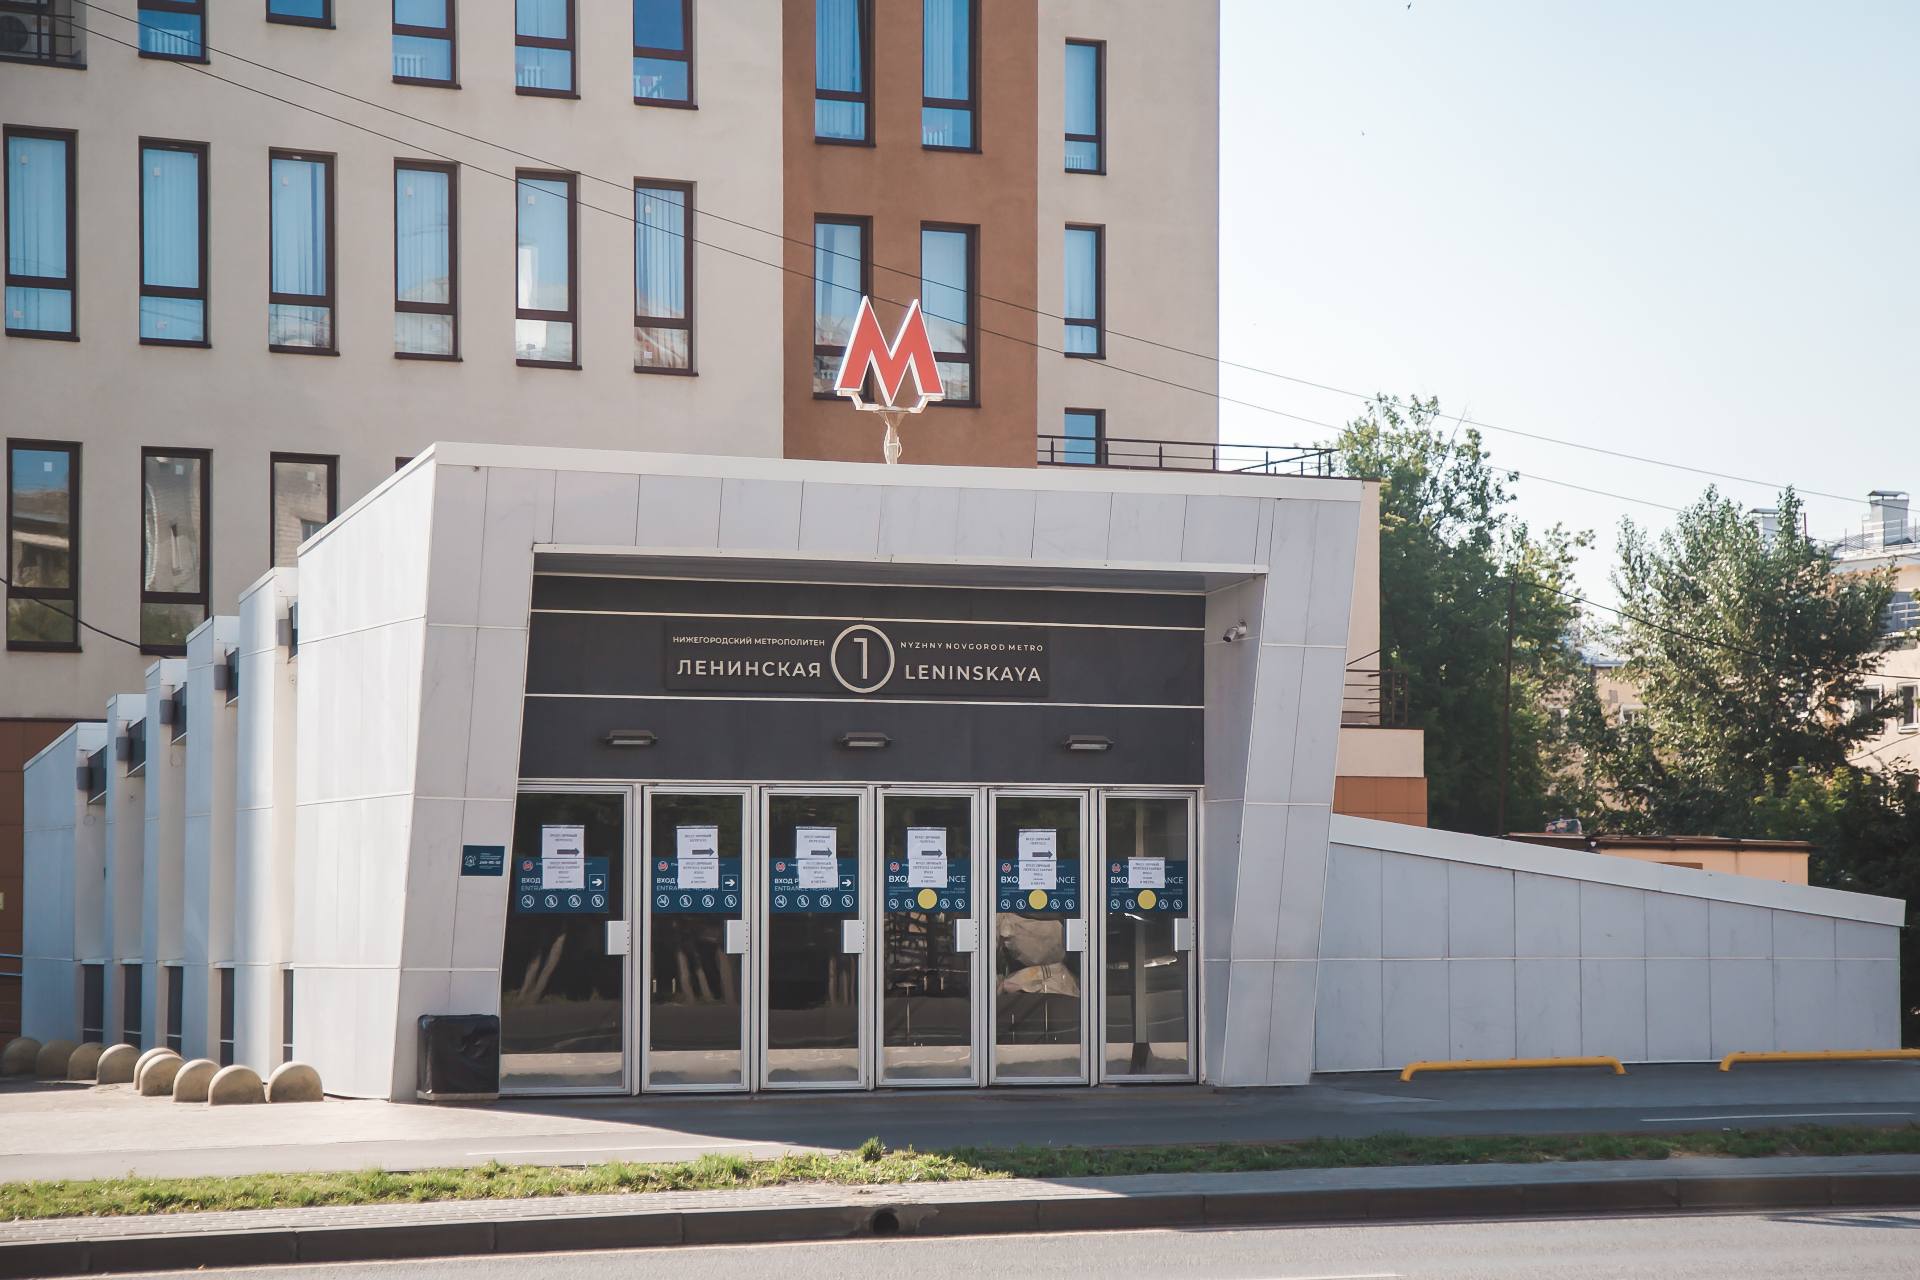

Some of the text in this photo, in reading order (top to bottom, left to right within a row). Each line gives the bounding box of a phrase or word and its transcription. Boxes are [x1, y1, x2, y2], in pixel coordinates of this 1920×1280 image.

[672, 635, 825, 647] НИЖЕГОРОДСКИЙ МЕТРОПОЛИТЕН
[900, 641, 1043, 652] NYZHNY NOVGOROD METRO
[854, 637, 868, 680] 1
[677, 659, 821, 678] ЛЕНИНСКАЯ
[905, 665, 1041, 682] LENINSKAYA
[774, 878, 793, 886] ВХОД
[888, 875, 909, 884] ВХО
[1000, 876, 1020, 884] ВХО
[1110, 876, 1129, 884] ВХО
